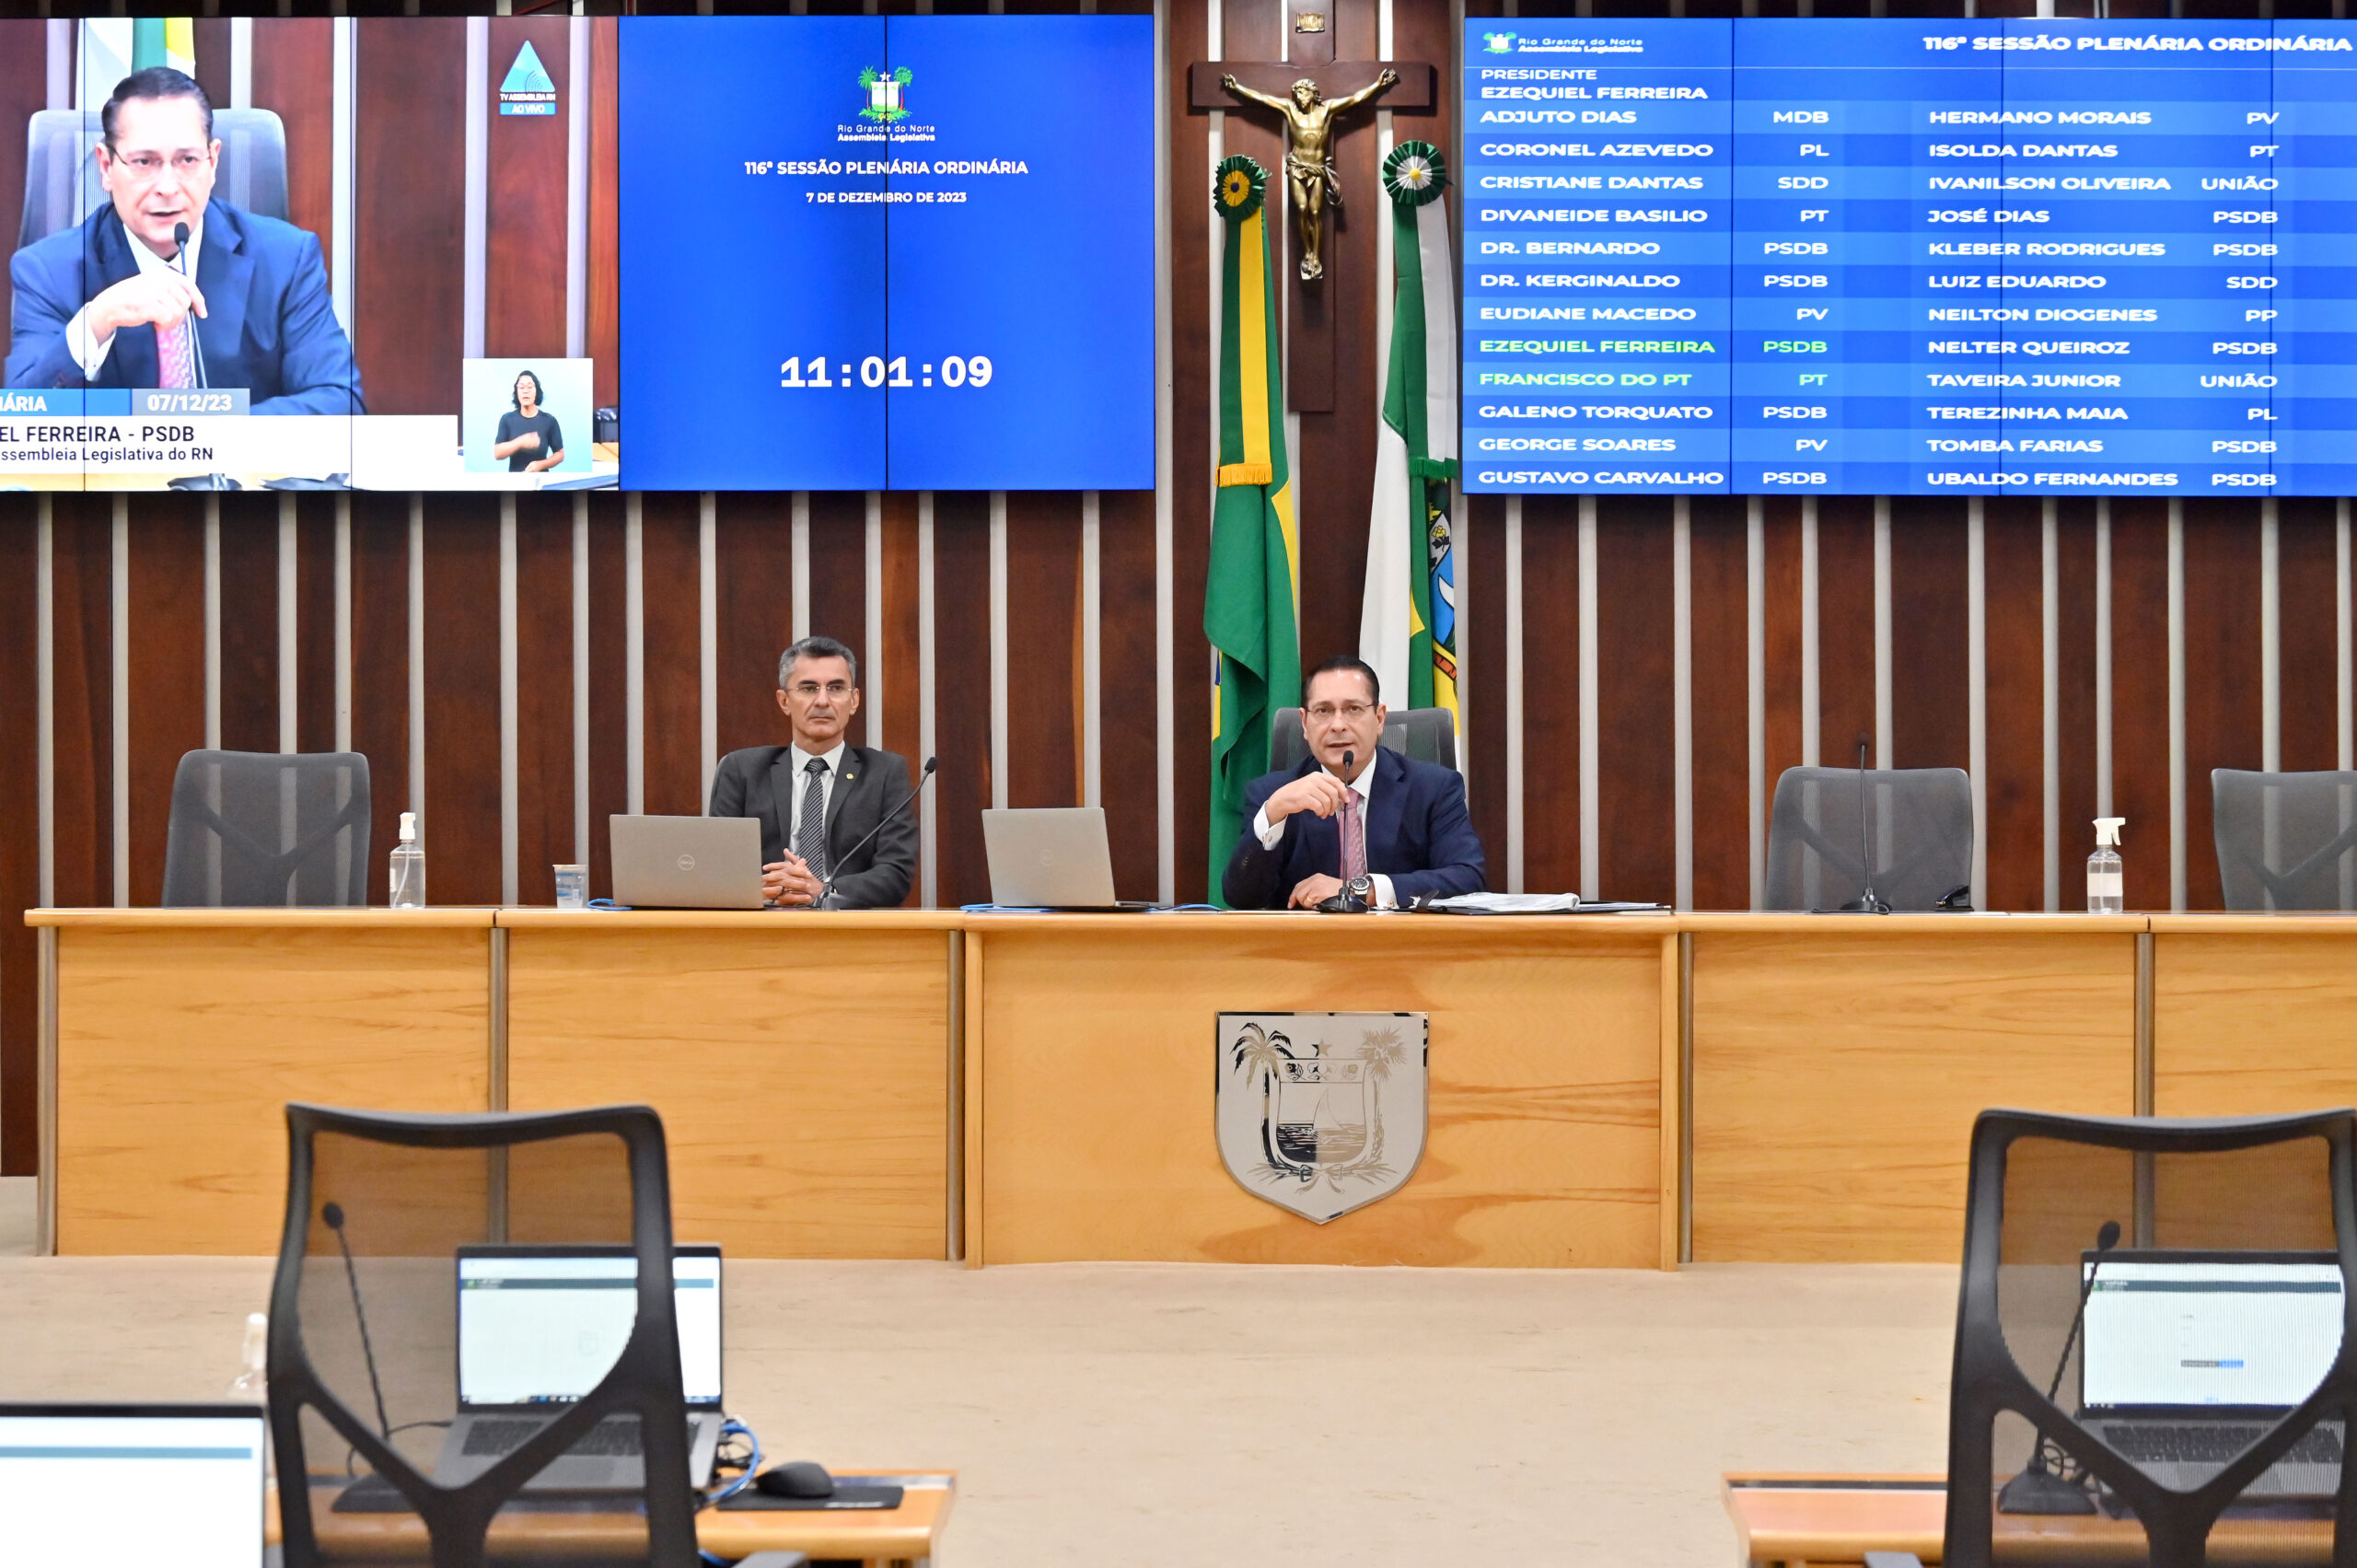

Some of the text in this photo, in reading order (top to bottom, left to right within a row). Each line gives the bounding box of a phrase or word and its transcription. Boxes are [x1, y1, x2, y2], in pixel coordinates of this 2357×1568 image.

[1922, 34, 2353, 52] 116ª SESSÃO PLENÁRIA ORDINÁRIA
[1480, 69, 1597, 80] PRESIDENTE
[1480, 87, 1709, 101] EZEQUIEL FERREIRA
[512, 104, 545, 113] AO VIVO
[1480, 110, 1638, 124] ADJUTO DIAS
[1773, 110, 1829, 124] MDB
[1929, 110, 2153, 125] HERMANO MORAIS
[2247, 111, 2280, 125] PV
[837, 124, 935, 134] Rio Grande do Norte
[1480, 143, 1714, 157] CORONEL AZEVEDO
[1800, 144, 1830, 157] PL
[1929, 144, 2119, 157] ISOLDA DANTAS
[2249, 145, 2280, 157] PT
[744, 157, 1029, 175] 116ª SESSÃO PLENÁRIA ORDINÁRIA
[1480, 176, 1704, 190] CRISTIANE DANTAS
[1778, 176, 1829, 190] SDD
[1929, 177, 2172, 191] IVANILSON OLIVEIRA
[2201, 175, 2279, 191] UNIÃO
[806, 192, 968, 203] 7 DE DEZEMBRO DE 2023
[1480, 209, 1708, 223] DIVANEIDE BASILIO
[1800, 209, 1829, 222] PT
[1927, 207, 2050, 223] JOSÉ DIAS
[2213, 211, 2279, 224] PSDB
[1480, 241, 1661, 255] DR. BERNARDO
[1764, 242, 1829, 255] PSDB
[1929, 242, 2166, 256] KLEBER RODRIGUES
[2212, 243, 2279, 257] PSDB
[1480, 274, 1681, 288] DR. KERGINALDO
[1764, 274, 1829, 287] PSDB
[1929, 275, 2107, 288] LUIZ EDUARDO
[2226, 276, 2278, 289] SDD
[1480, 307, 1697, 320] EUDIANE MACEDO
[1796, 308, 1829, 320] PV
[1928, 308, 2158, 322] NEILTON DIOGENES
[2246, 309, 2279, 322] PP
[1480, 340, 1715, 354] EZEQUIEL FERREIRA
[1764, 341, 1828, 353] PSDB
[1928, 341, 2131, 356] NELTER QUEIROZ
[2212, 342, 2278, 354] PSDB
[781, 355, 993, 388] 11:01:09
[1480, 373, 1692, 386] FRANCISCO DO PT
[1800, 374, 1828, 386] PT
[1926, 374, 2121, 388] TAVEIRA JUNIOR
[2200, 372, 2278, 389] UNIÃO
[147, 394, 233, 412] 07/12/23
[1479, 405, 1713, 421] GALENO TORQUATO
[1763, 406, 1828, 419] PSDB
[1926, 407, 2130, 420] TEREZINHA MAIA
[2247, 408, 2278, 421] PL
[0, 426, 20, 442] EL
[27, 426, 122, 443] FERREIRA
[142, 426, 194, 442] PSDB
[1478, 437, 1677, 452] GEORGE SOARES
[1795, 438, 1829, 452] PV
[1925, 439, 2104, 453] TOMBA FARIAS
[2212, 440, 2278, 454] PSDB
[82, 447, 163, 464] Legislativa
[168, 447, 186, 460] do
[192, 447, 213, 460] RN
[1478, 470, 1724, 484] GUSTAVO CARVALHO
[1762, 471, 1828, 484] PSDB
[1927, 472, 2179, 486] UBALDO FERNANDES
[2212, 473, 2277, 486] PSDB
